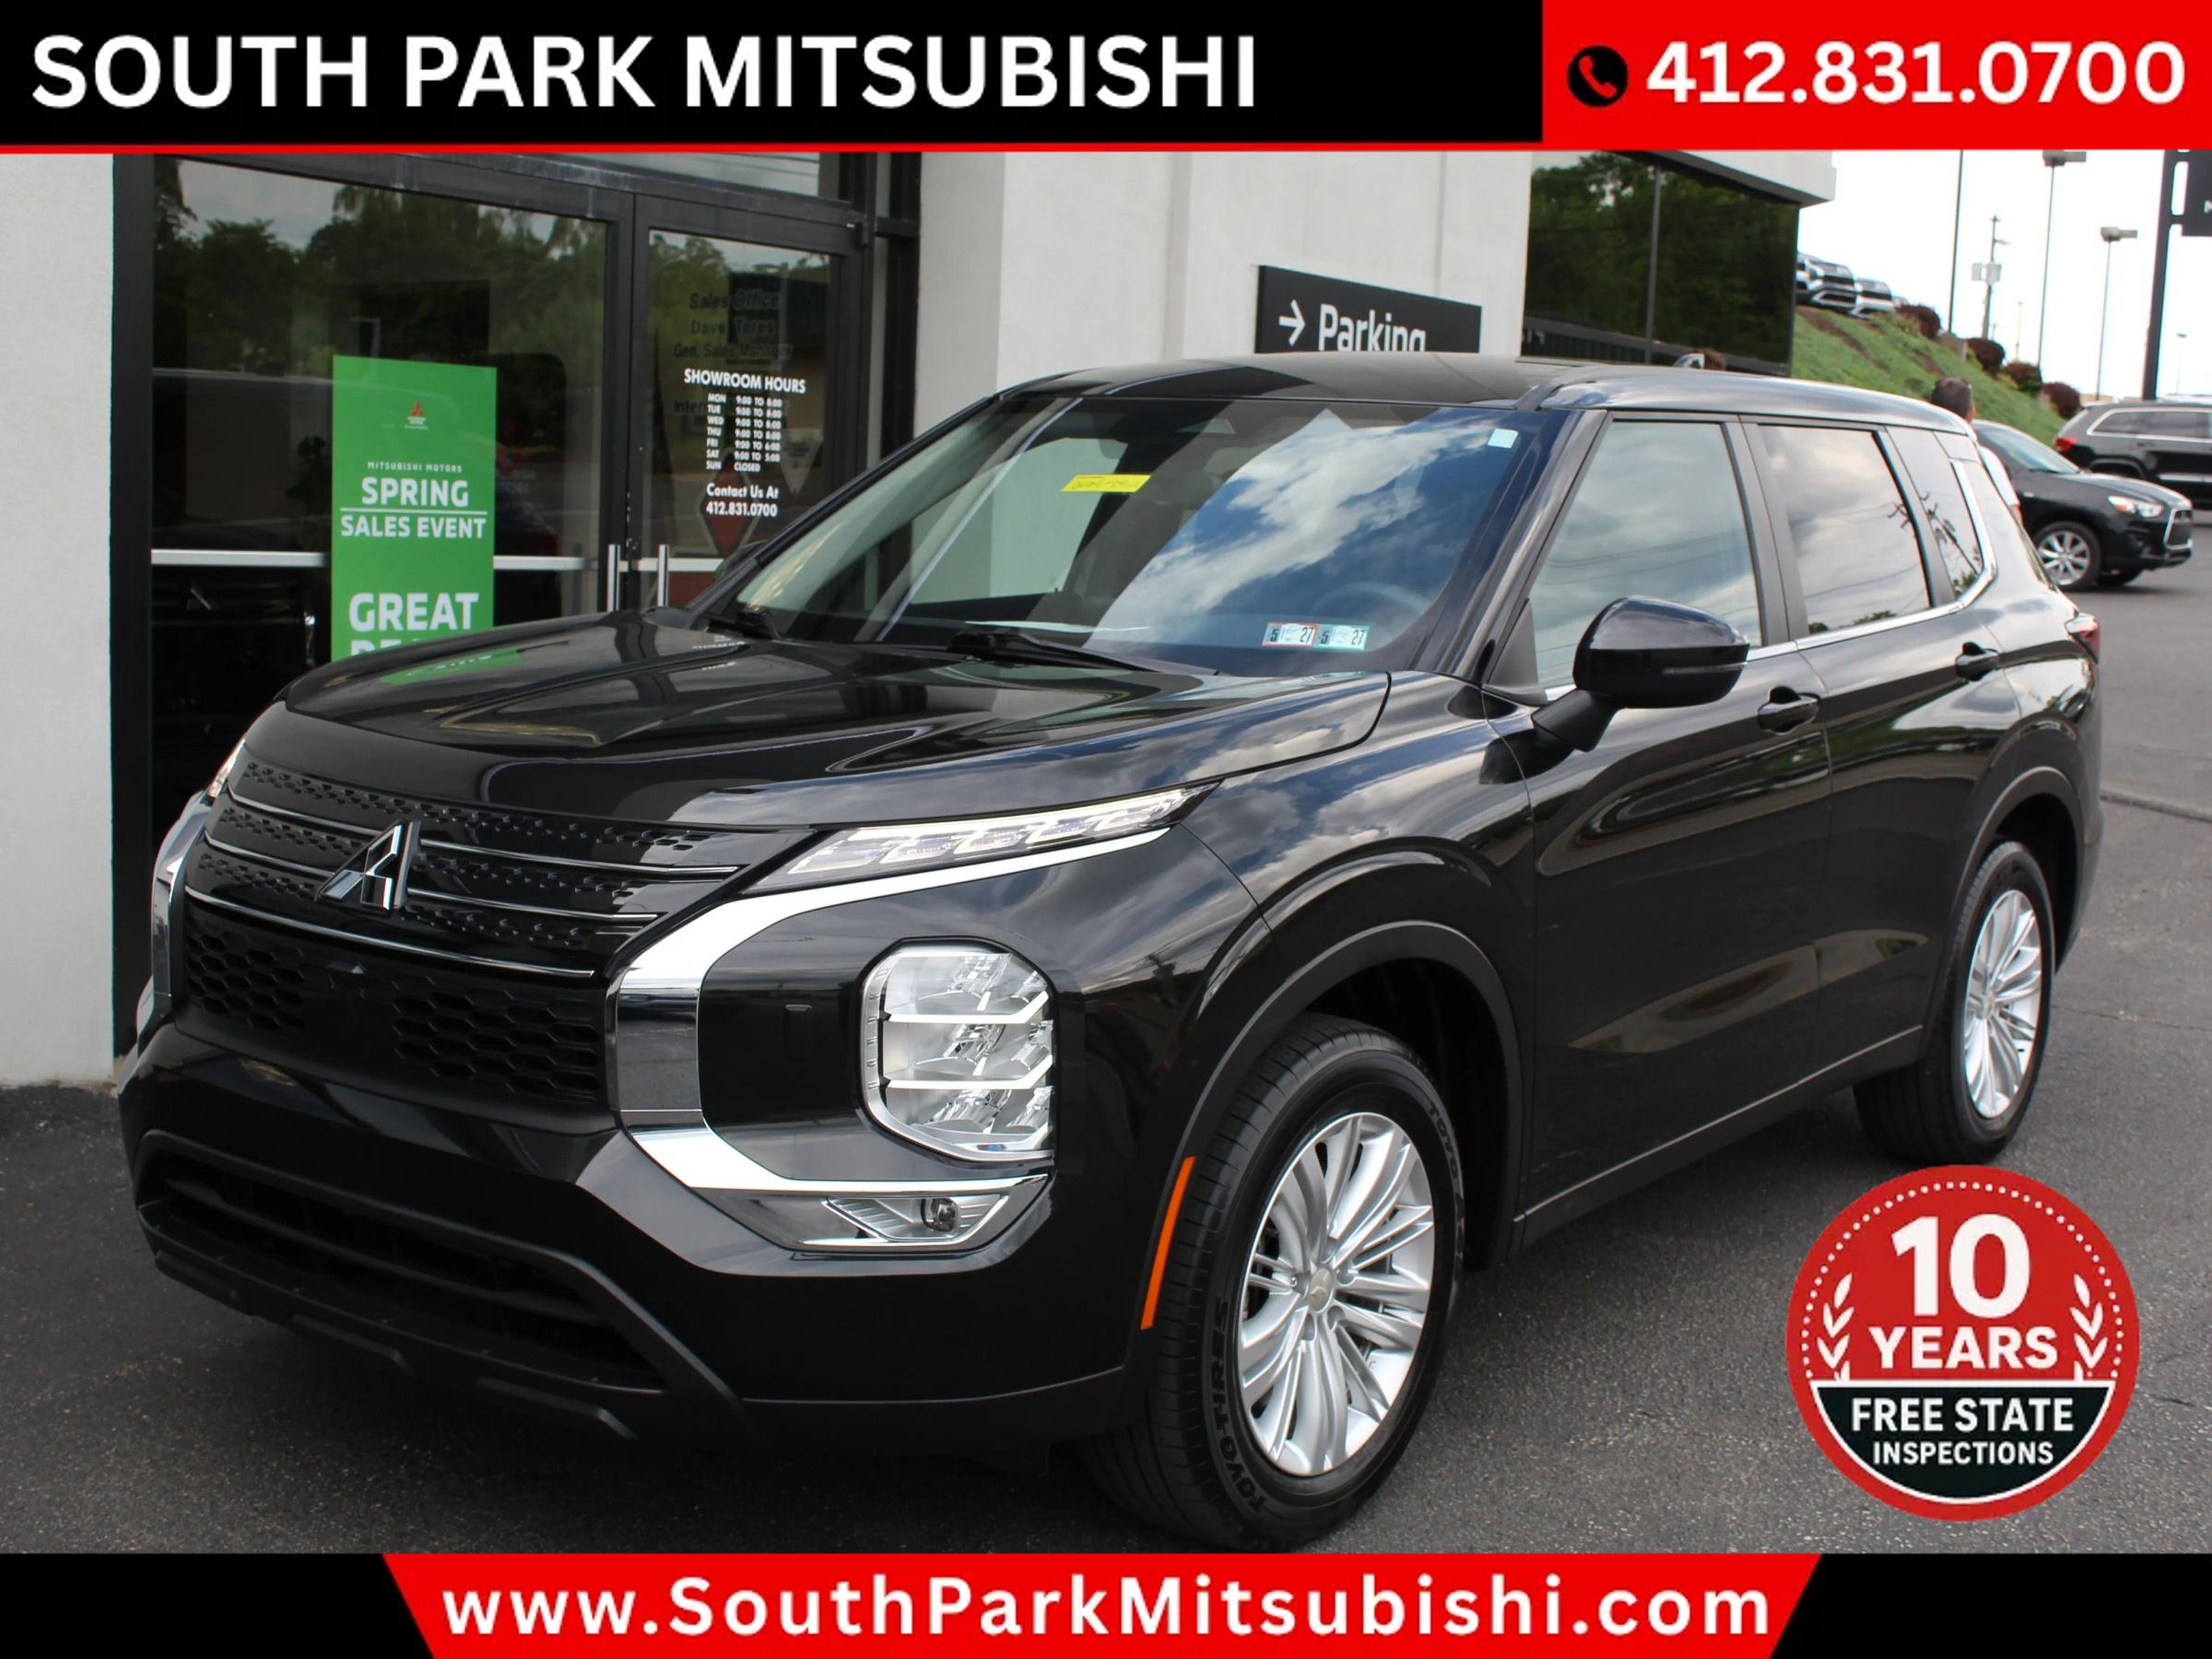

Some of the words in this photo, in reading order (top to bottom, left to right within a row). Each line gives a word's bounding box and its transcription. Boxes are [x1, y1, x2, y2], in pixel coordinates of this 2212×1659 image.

[684, 368, 762, 390] SHOWROOM
[764, 375, 806, 394] HOURS
[708, 393, 726, 403] MON
[754, 396, 765, 406] TO
[707, 404, 722, 414] TUE
[753, 407, 764, 418] TO
[707, 415, 724, 426] WED
[753, 418, 764, 429] TO
[706, 426, 723, 437] THU
[752, 429, 764, 440] TO
[706, 438, 719, 448] FRI
[752, 441, 763, 451] TO
[706, 449, 720, 459] SAT
[751, 452, 761, 462] TO
[367, 461, 422, 471] MITSUBISHI
[426, 464, 463, 473] MOTORS
[706, 460, 723, 471] SUN
[734, 462, 761, 473] CLOSED
[361, 476, 469, 508] SPRING
[706, 482, 747, 499] Contact
[749, 484, 764, 500] Us
[765, 485, 780, 500] At
[706, 500, 778, 517] 412.831.0700
[339, 514, 411, 538] SALES
[417, 516, 487, 539] EVENT
[348, 592, 479, 632] GREAT
[1270, 629, 1279, 642] 5
[1300, 627, 1313, 643] 27
[1321, 630, 1330, 644] 5
[1351, 629, 1364, 646] 27
[1219, 1434, 1266, 1513] TOYO
